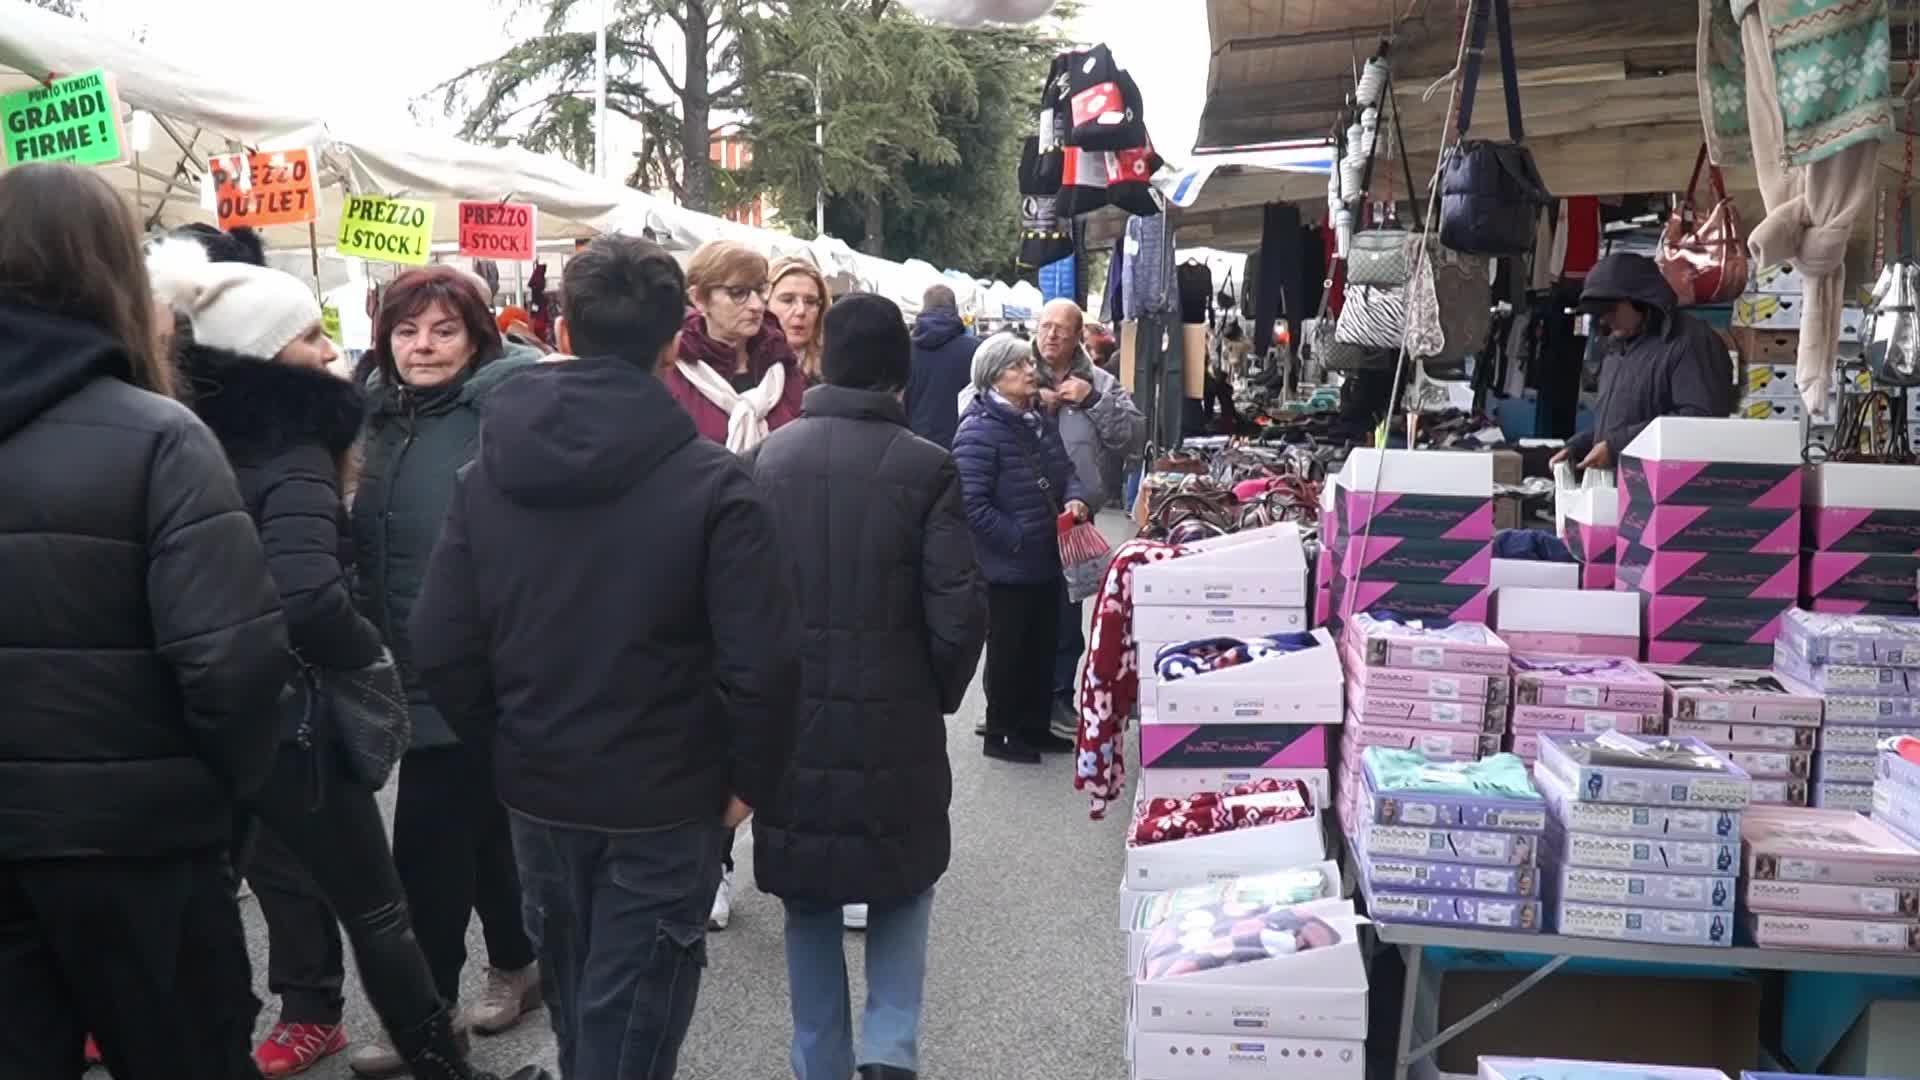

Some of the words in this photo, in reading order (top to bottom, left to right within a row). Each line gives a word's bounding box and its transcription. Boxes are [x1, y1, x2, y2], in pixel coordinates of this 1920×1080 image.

[62, 74, 101, 94] VENDITA
[8, 90, 106, 133] GRANDI
[16, 124, 93, 161] FIRME
[218, 188, 309, 219] OUTLET
[348, 199, 425, 228] PREZZO
[463, 206, 528, 227] PREZZO
